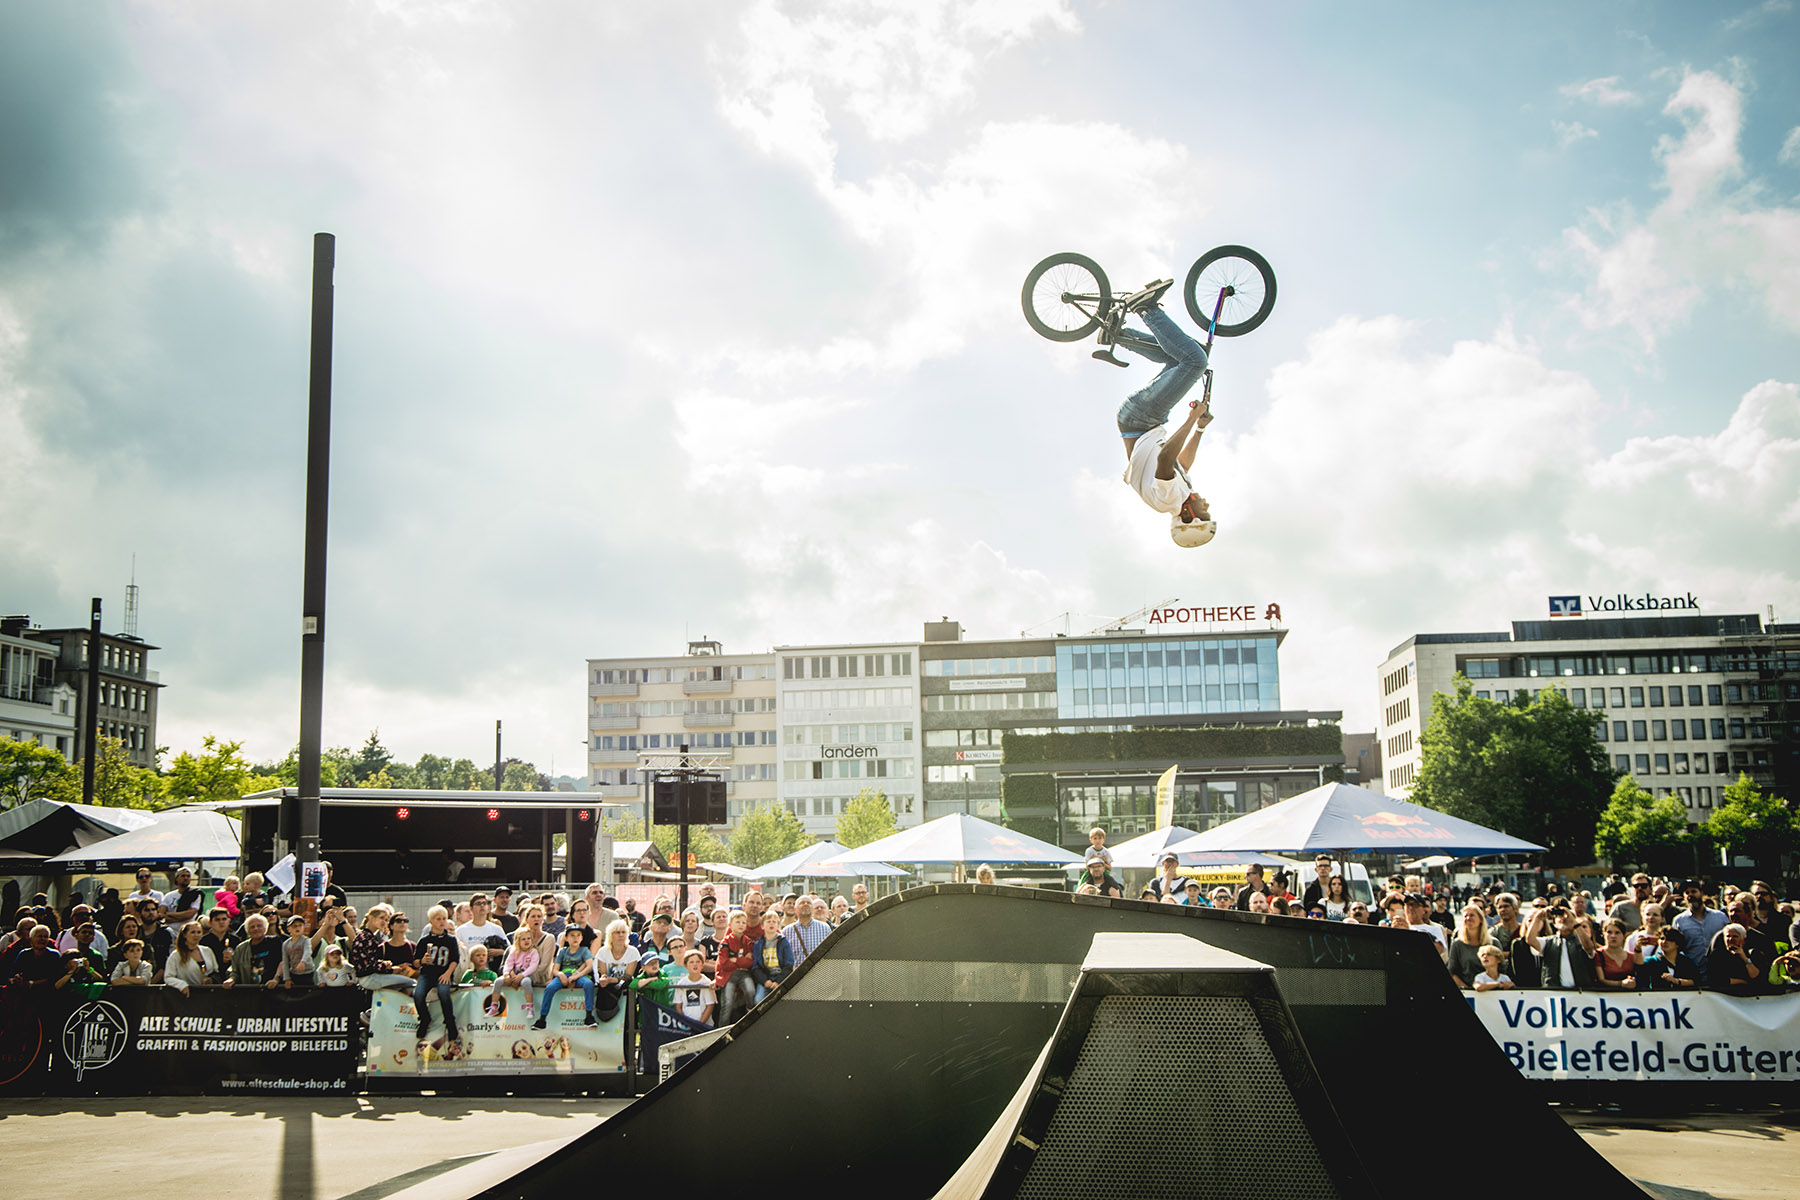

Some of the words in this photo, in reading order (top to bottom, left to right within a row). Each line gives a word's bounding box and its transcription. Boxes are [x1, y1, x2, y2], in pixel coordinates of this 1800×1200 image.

[1589, 592, 1698, 611] Volksbank
[1149, 605, 1257, 624] APOTHEKE
[1407, 826, 1457, 839] Bull
[399, 1005, 416, 1015] EA
[559, 1001, 587, 1011] SMA
[1499, 997, 1694, 1030] Volksbank
[139, 1016, 170, 1032] ALTE
[173, 1016, 222, 1033] SCHULE
[236, 1017, 281, 1033] URBAN
[285, 1017, 349, 1033] LIFESTYLE
[467, 1022, 500, 1032] Charly's
[501, 1023, 526, 1031] house
[136, 1039, 188, 1051] GRAFFITI
[191, 1039, 200, 1051] &
[203, 1040, 287, 1052] FASHIONSHOP
[291, 1040, 348, 1052] BIELEFELD
[221, 1078, 347, 1090] www.alteschule-shop.de
